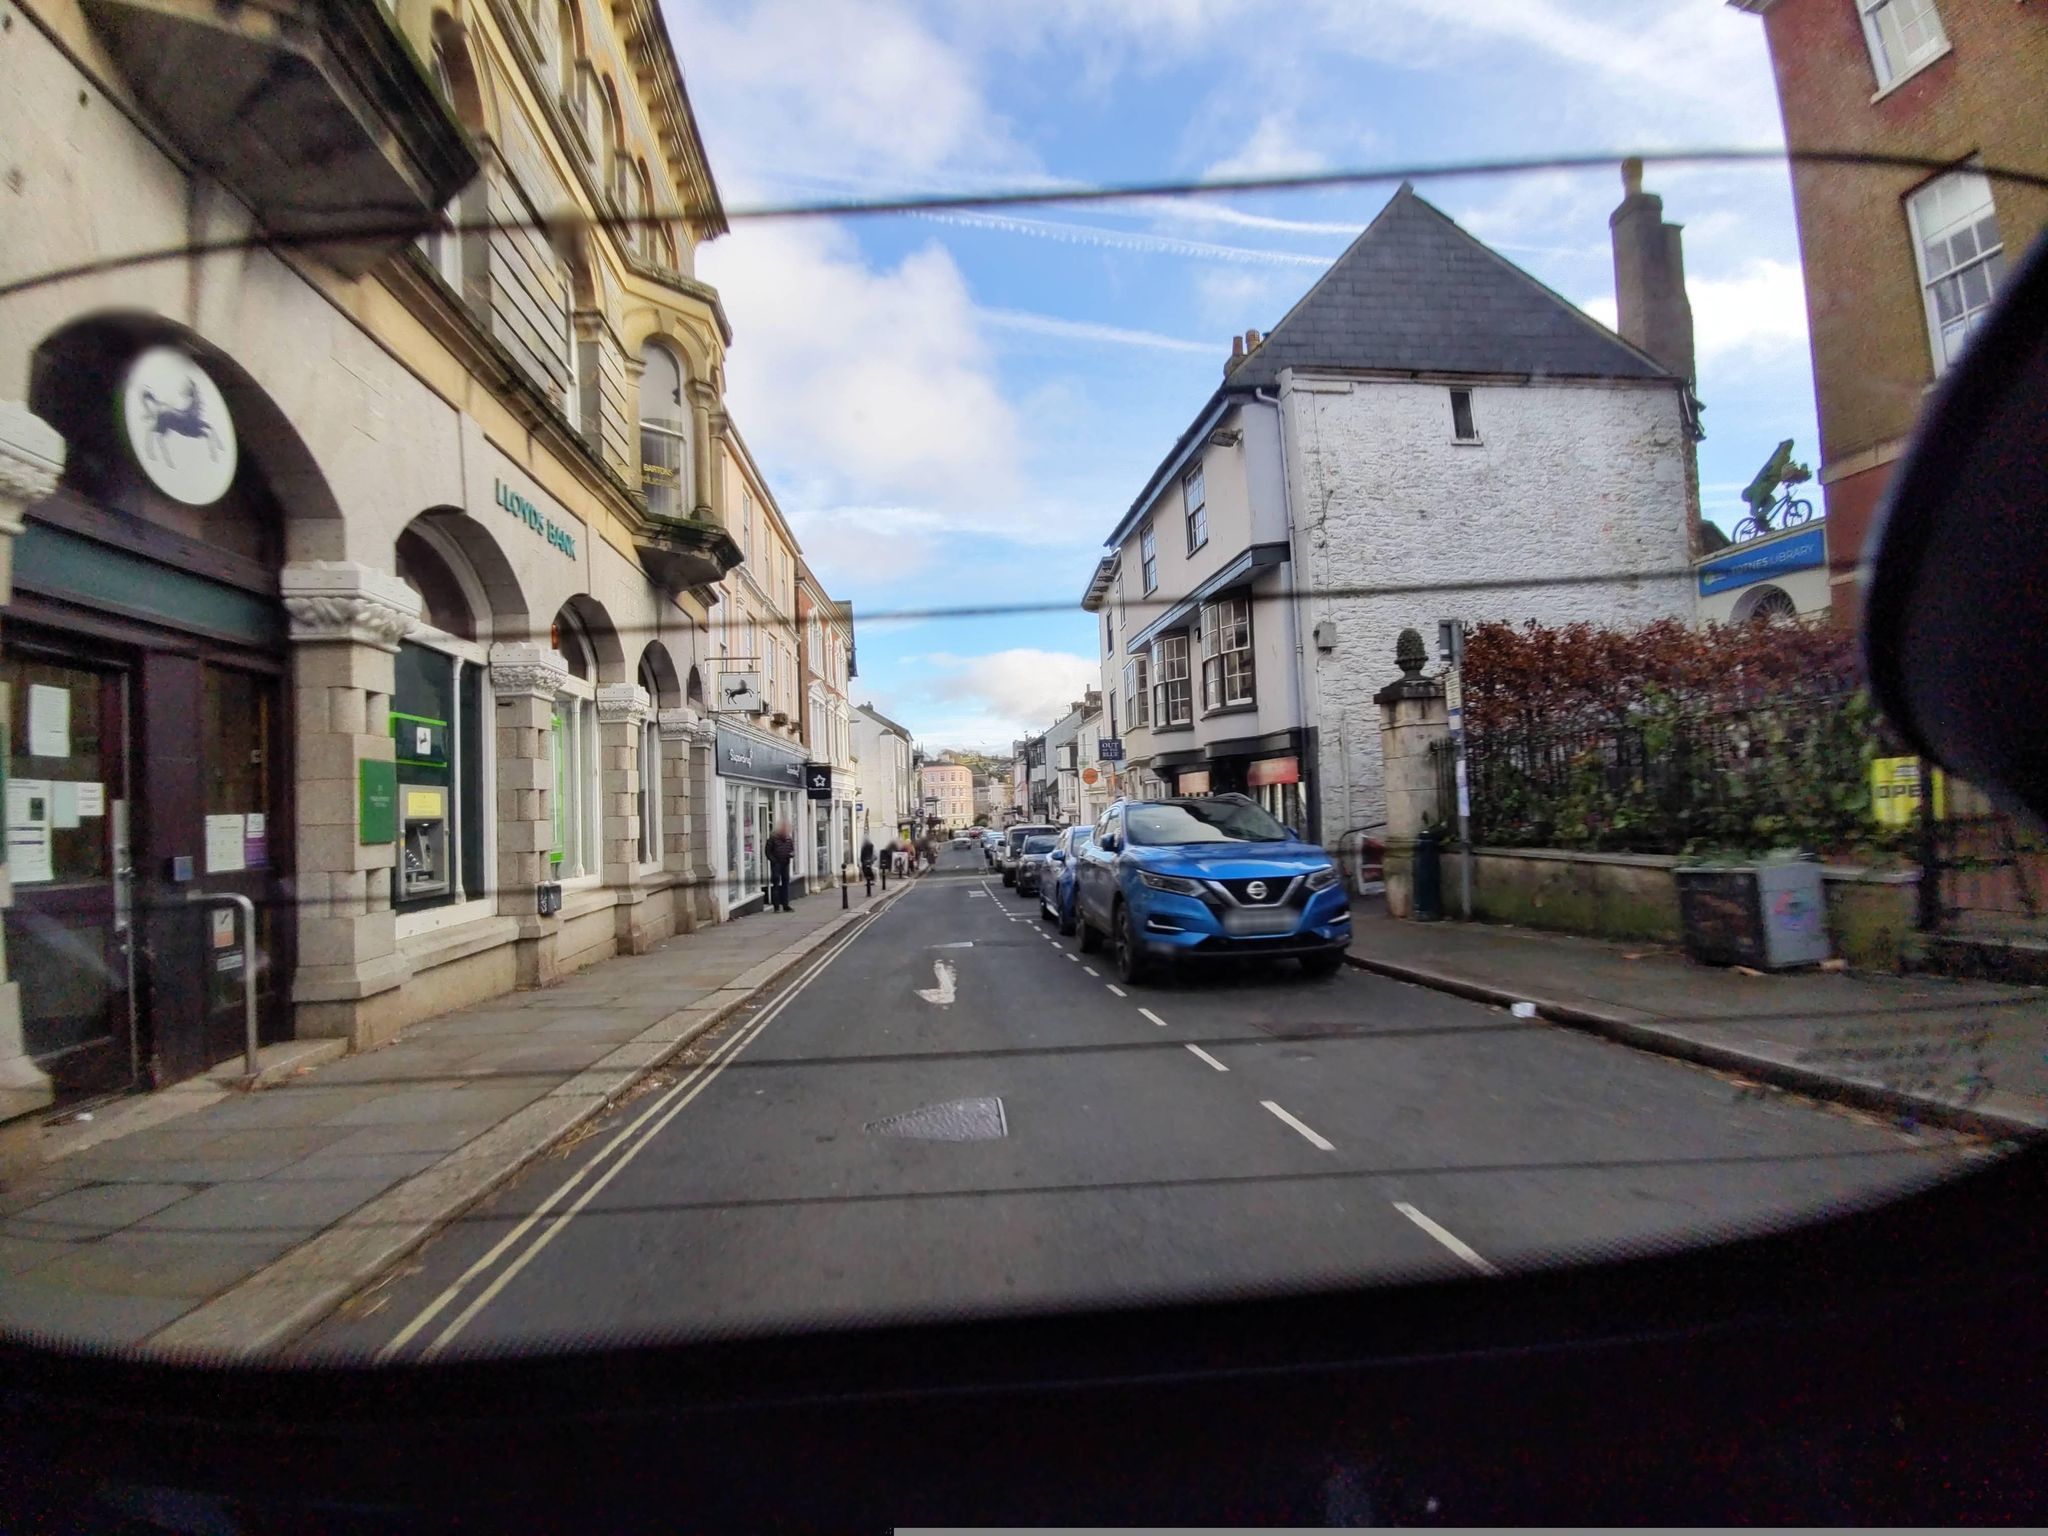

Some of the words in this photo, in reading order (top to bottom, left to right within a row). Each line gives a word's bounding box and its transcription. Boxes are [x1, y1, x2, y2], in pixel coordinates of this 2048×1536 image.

[495, 477, 544, 536] LLOYDS
[547, 519, 577, 562] BANK
[1731, 556, 1769, 575] TOTNES
[1769, 543, 1815, 565] LIBRARY
